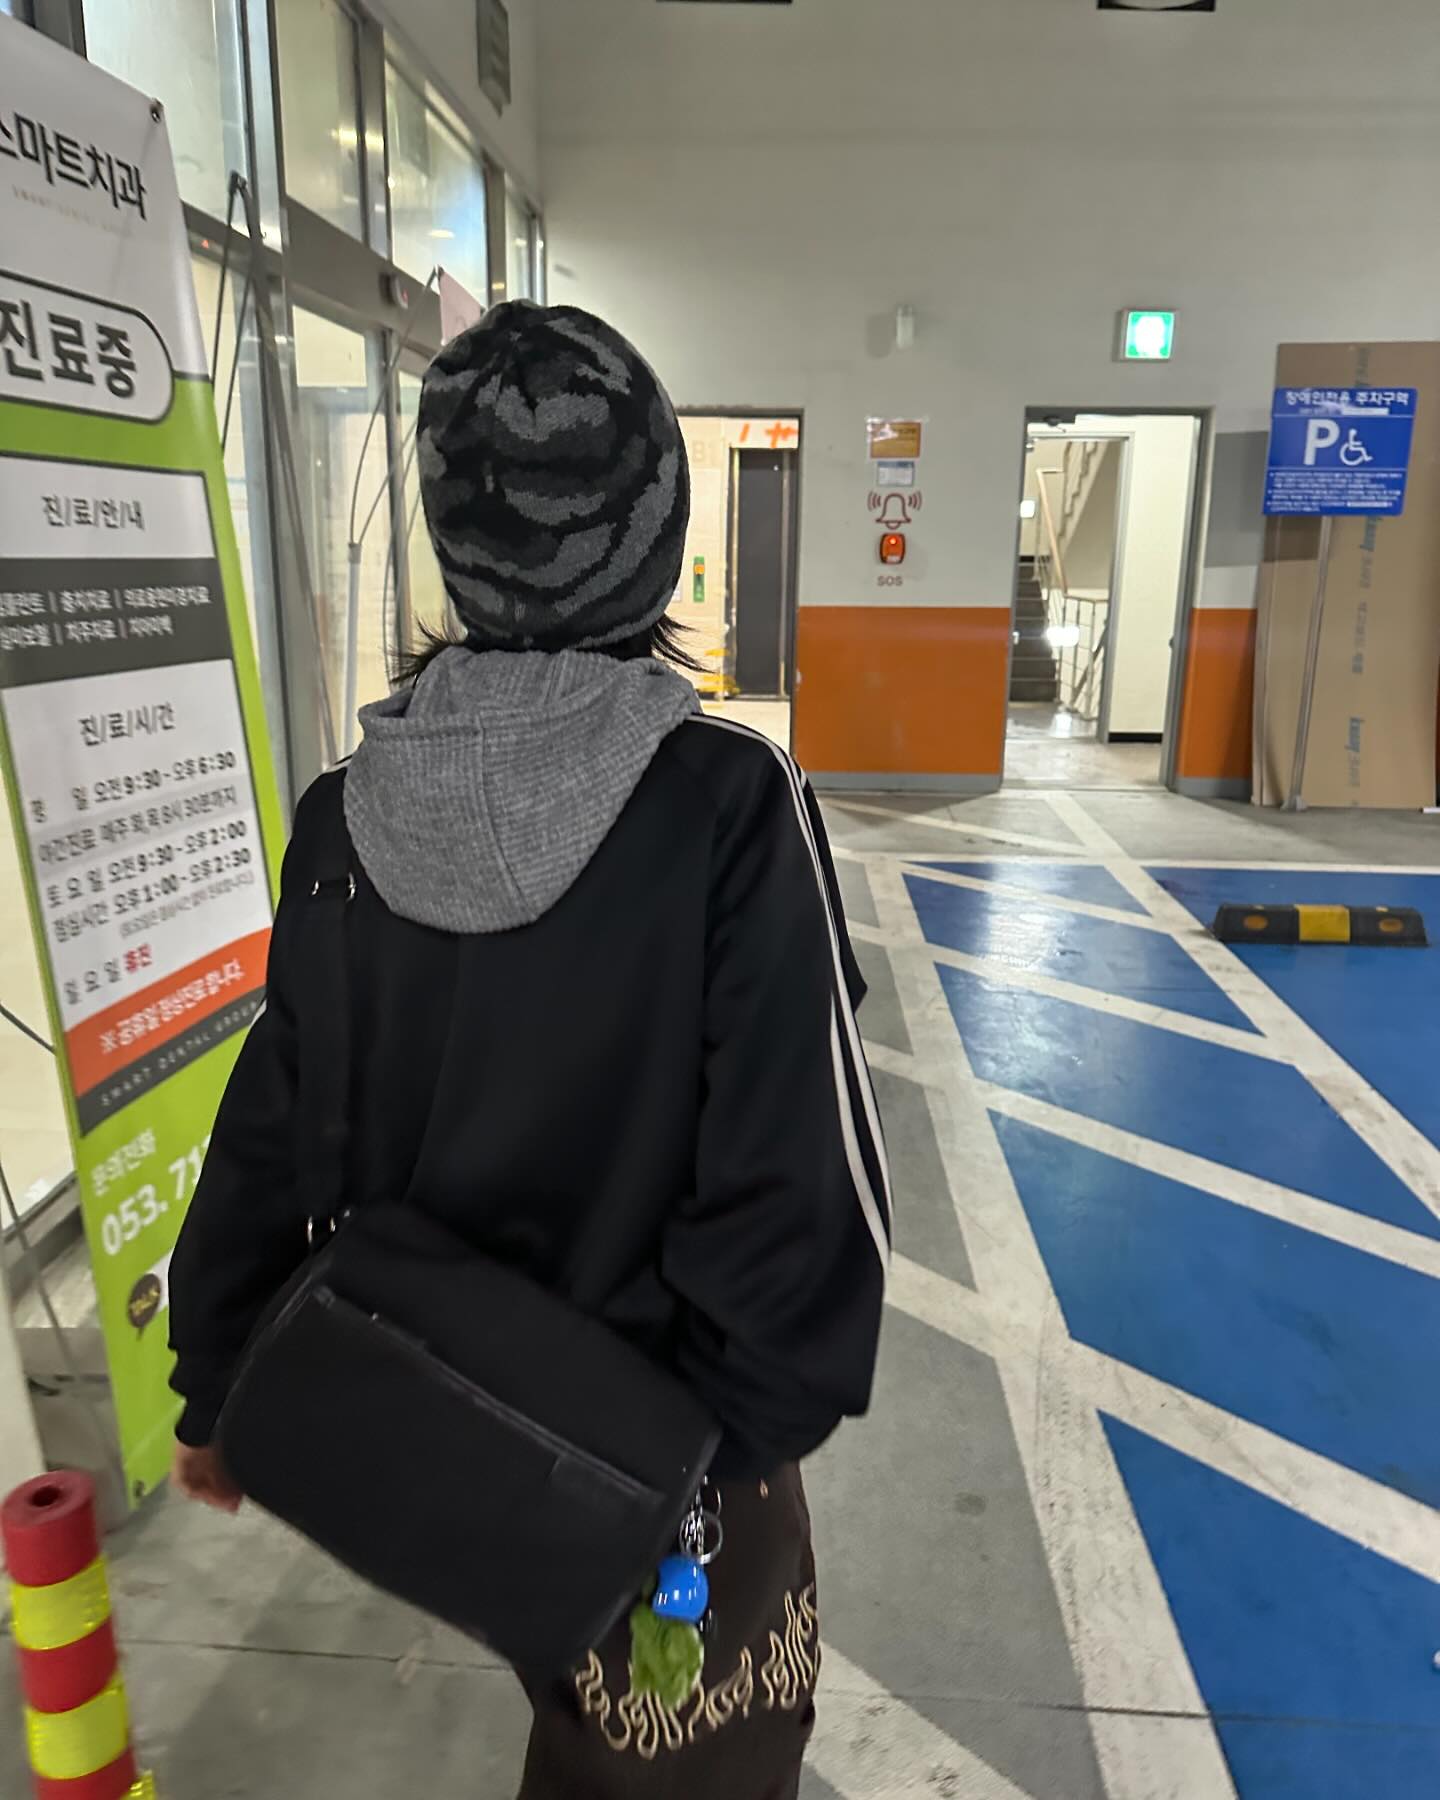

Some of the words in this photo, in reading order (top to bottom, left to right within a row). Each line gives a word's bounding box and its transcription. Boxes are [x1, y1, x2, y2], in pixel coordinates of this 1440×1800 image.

[0, 300, 138, 398] 진료중
[1356, 390, 1409, 406] 주차구역
[1303, 418, 1340, 465] P
[877, 575, 903, 586] SOS
